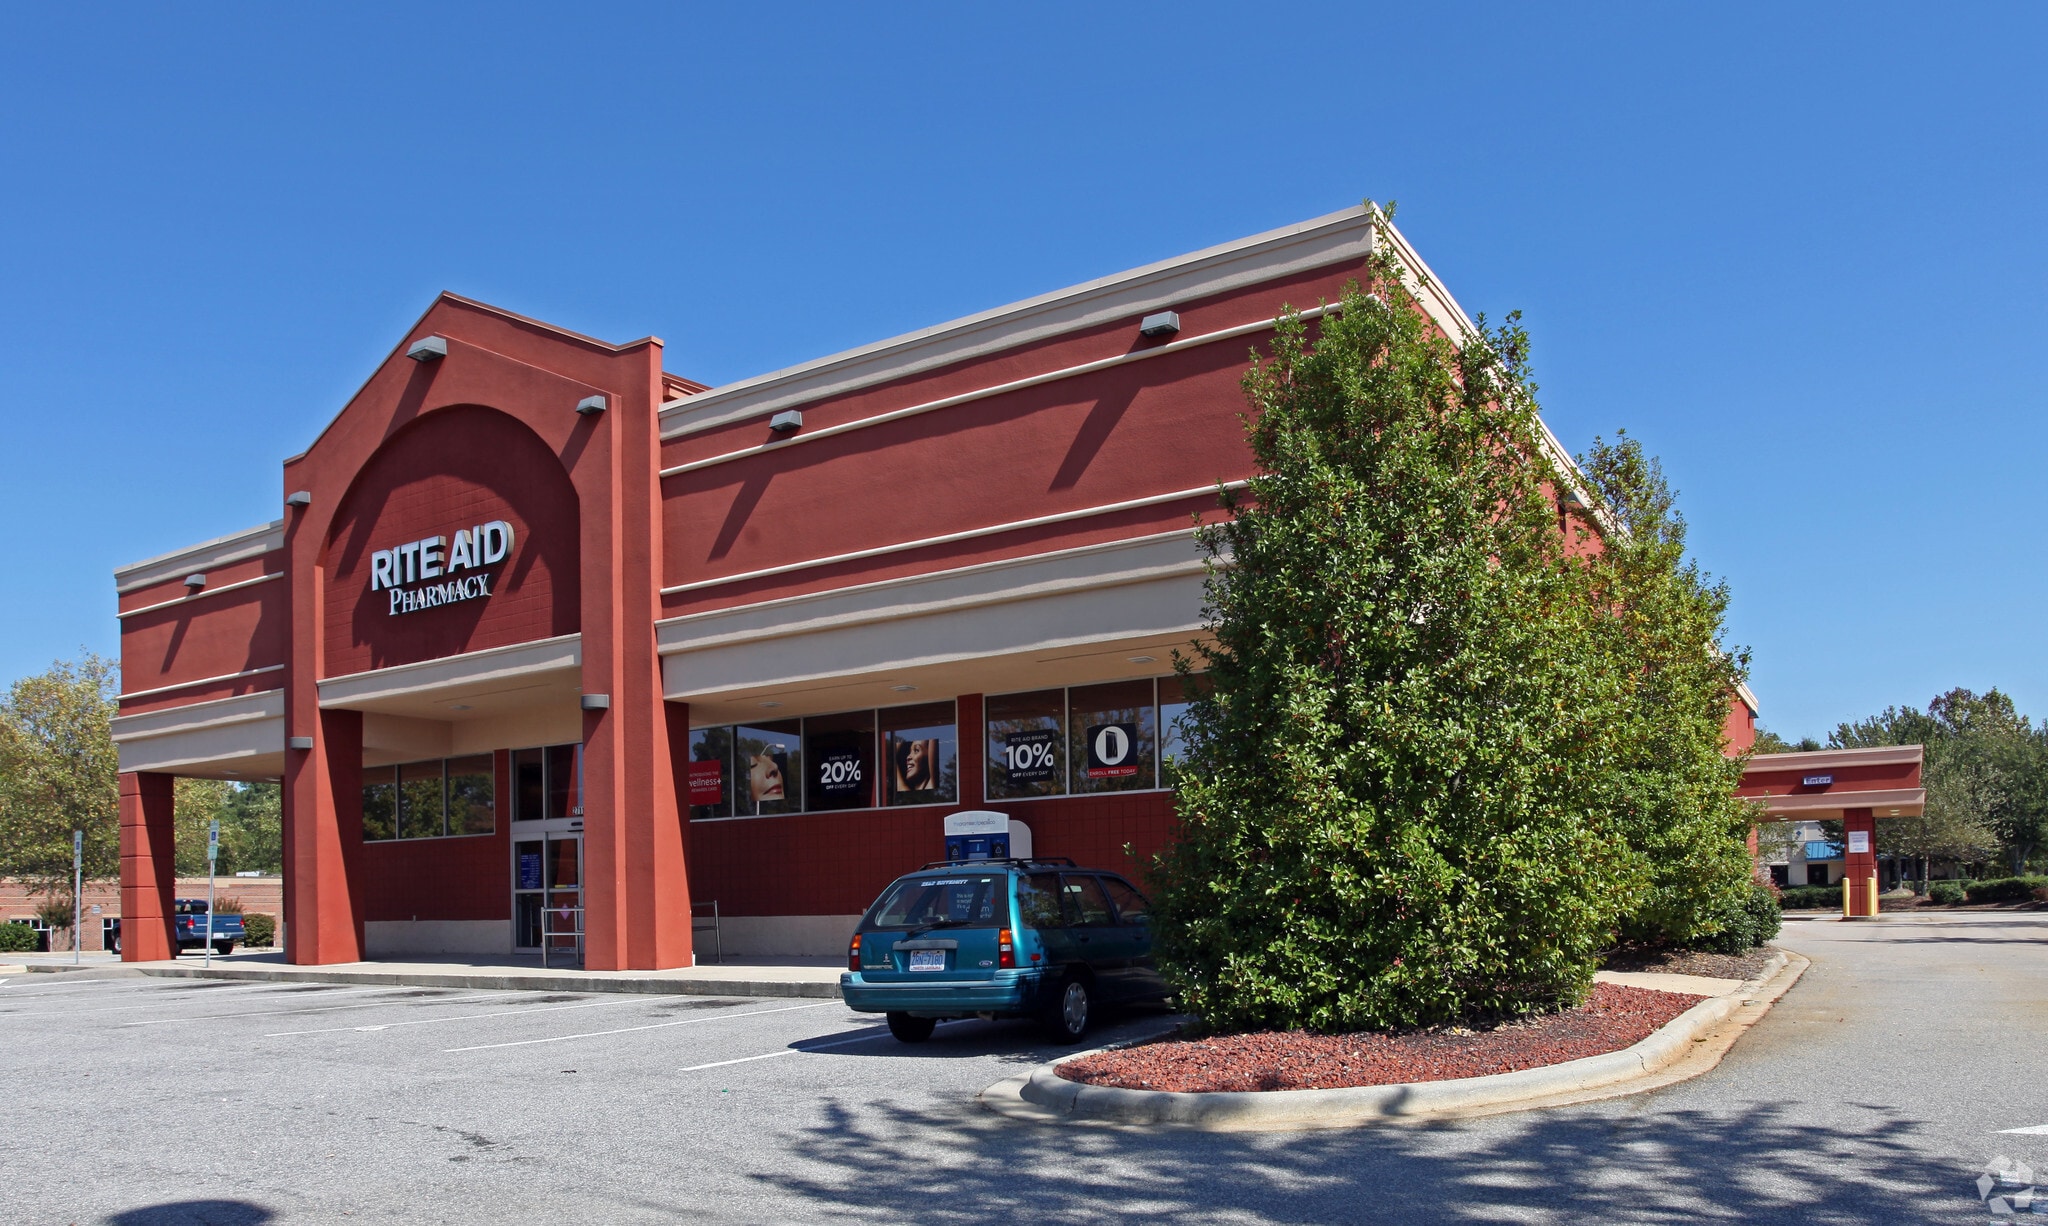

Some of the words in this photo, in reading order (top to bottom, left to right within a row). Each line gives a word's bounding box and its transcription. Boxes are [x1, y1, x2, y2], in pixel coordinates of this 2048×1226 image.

[371, 535, 446, 591] RITE
[447, 519, 515, 574] AID
[388, 572, 492, 616] PHARMACY
[1005, 741, 1054, 770] 10%
[820, 759, 862, 784] 20%
[1805, 777, 1830, 785] Enter
